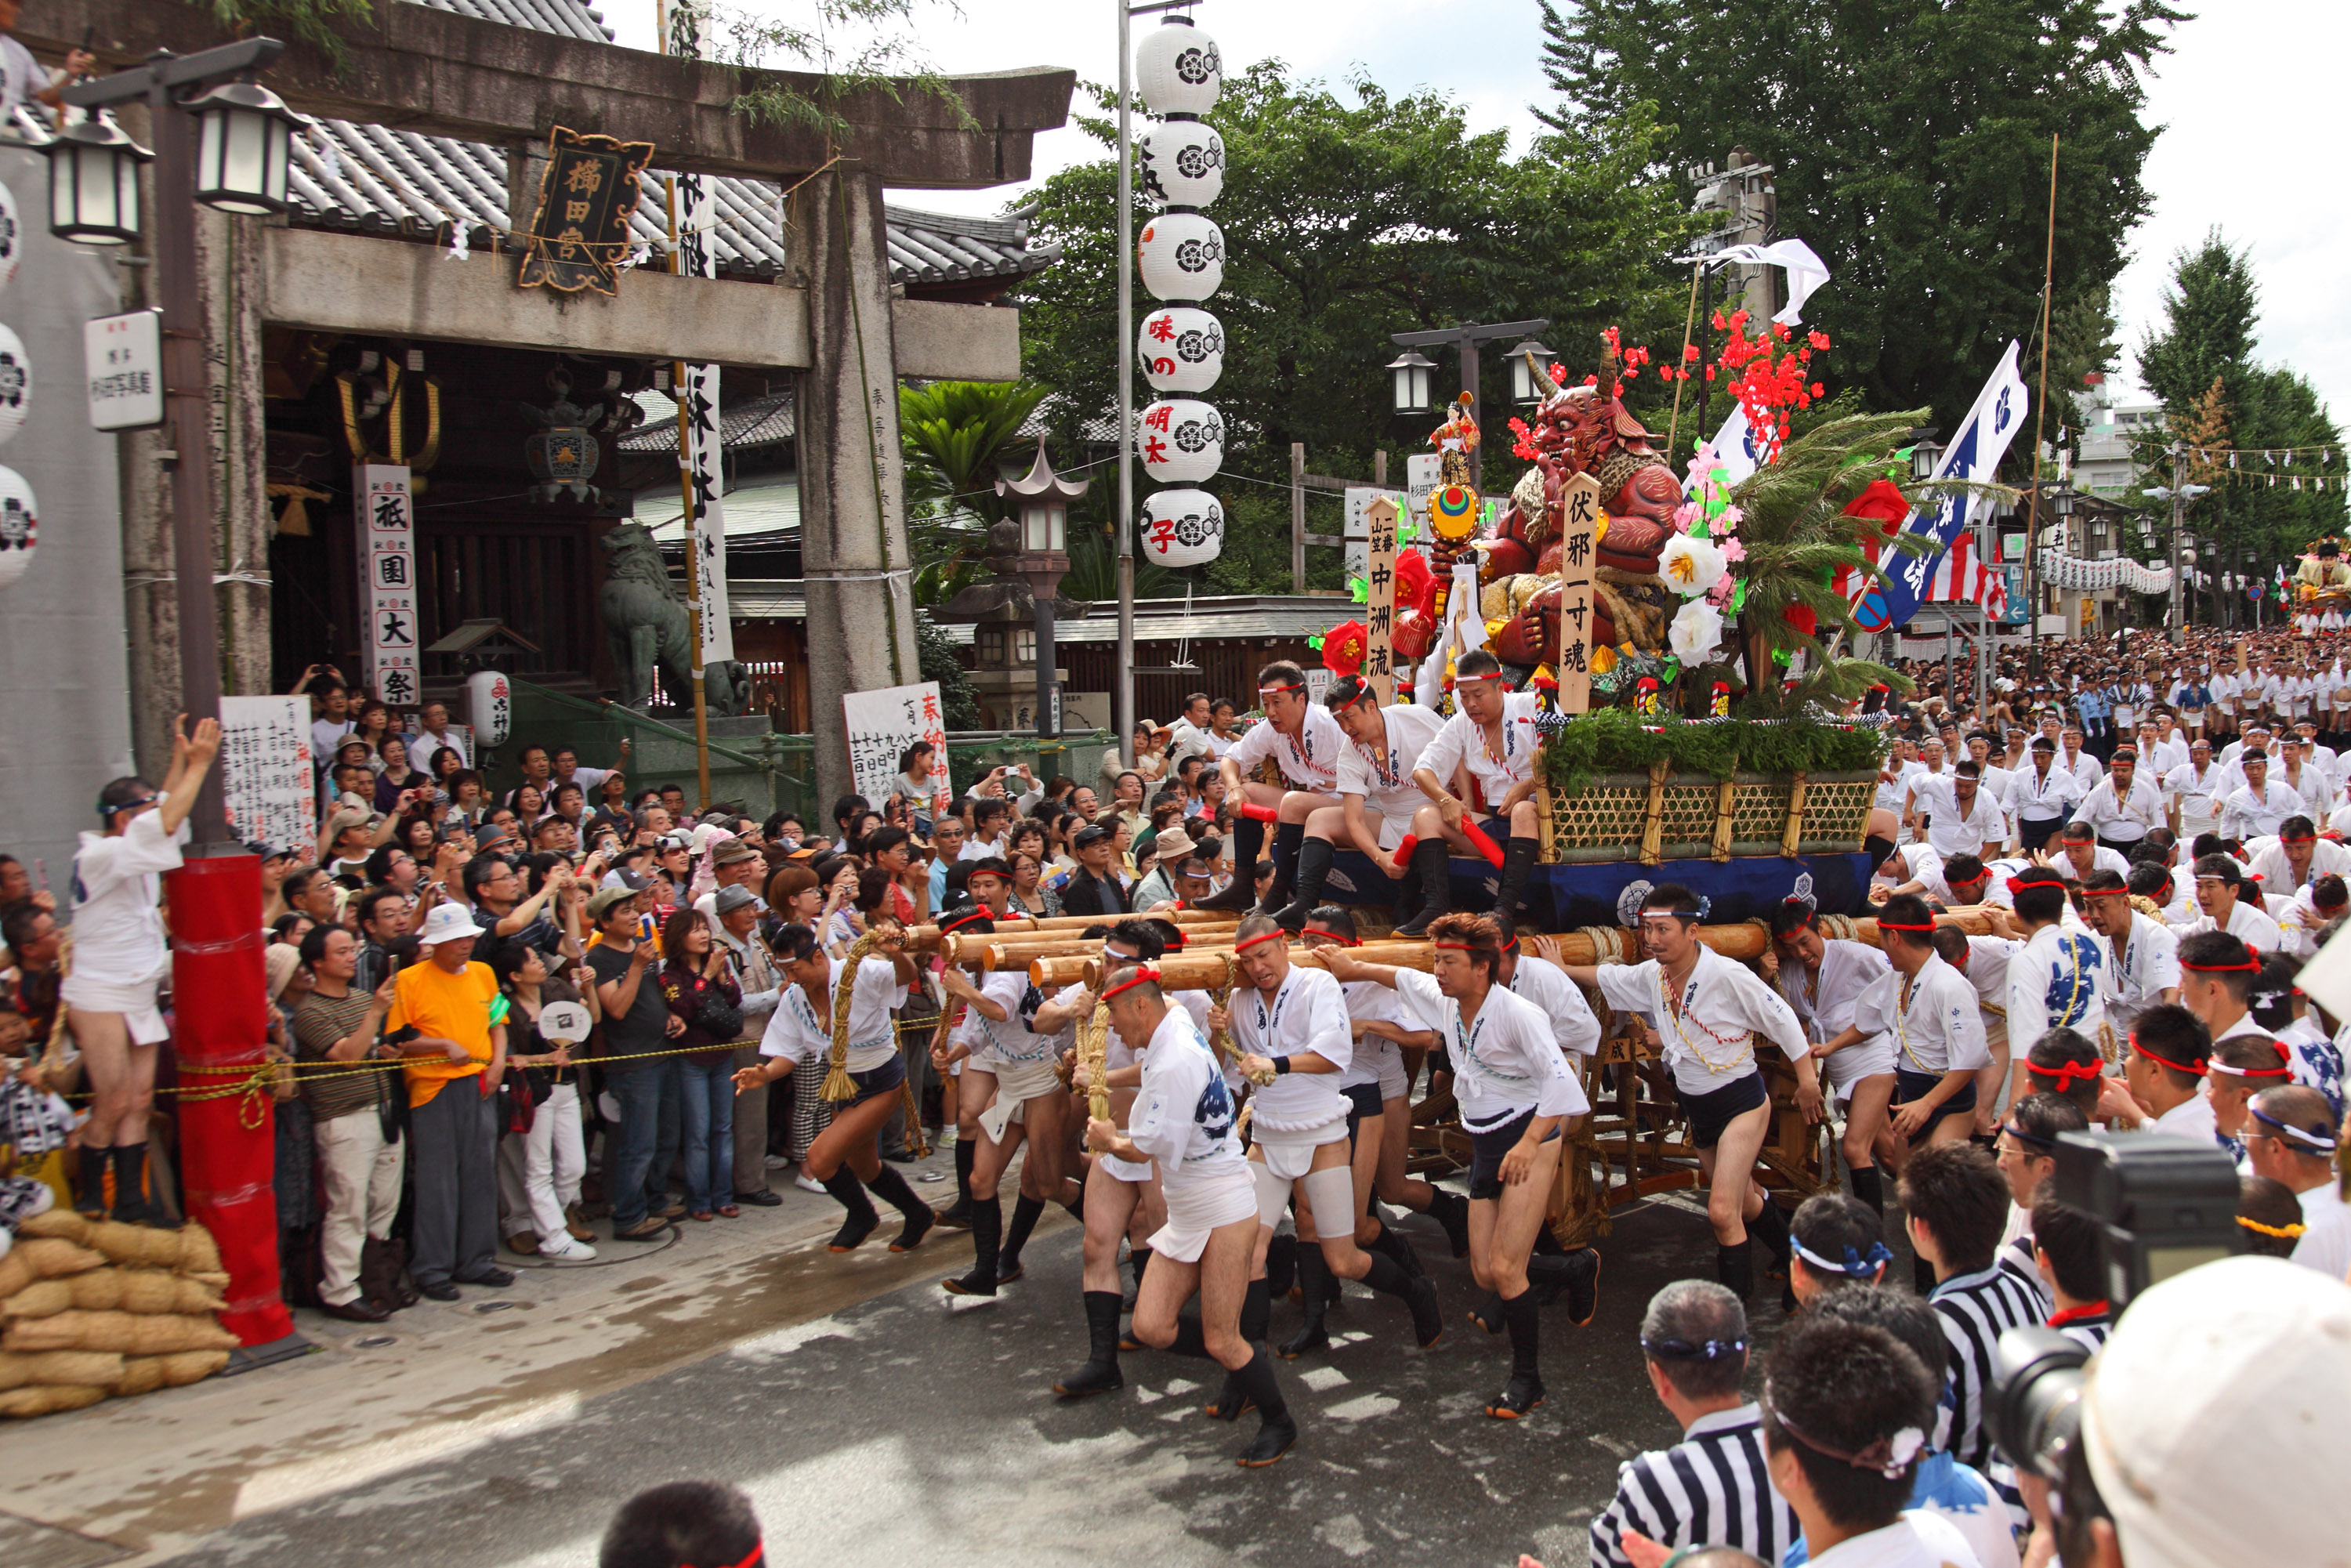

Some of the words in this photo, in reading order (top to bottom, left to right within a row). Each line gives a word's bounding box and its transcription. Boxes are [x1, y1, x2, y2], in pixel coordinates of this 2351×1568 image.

[558, 158, 603, 259] 櫛田宮
[1149, 315, 1177, 376] 味の
[1144, 406, 1174, 464] 明太
[1150, 519, 1177, 554] 子
[1371, 517, 1382, 552] 山笠
[1382, 517, 1393, 552] 二番
[1563, 491, 1593, 672] 伏邪一寸魂
[1369, 563, 1392, 677] 中洲流
[1951, 1008, 1962, 1030] 中二
